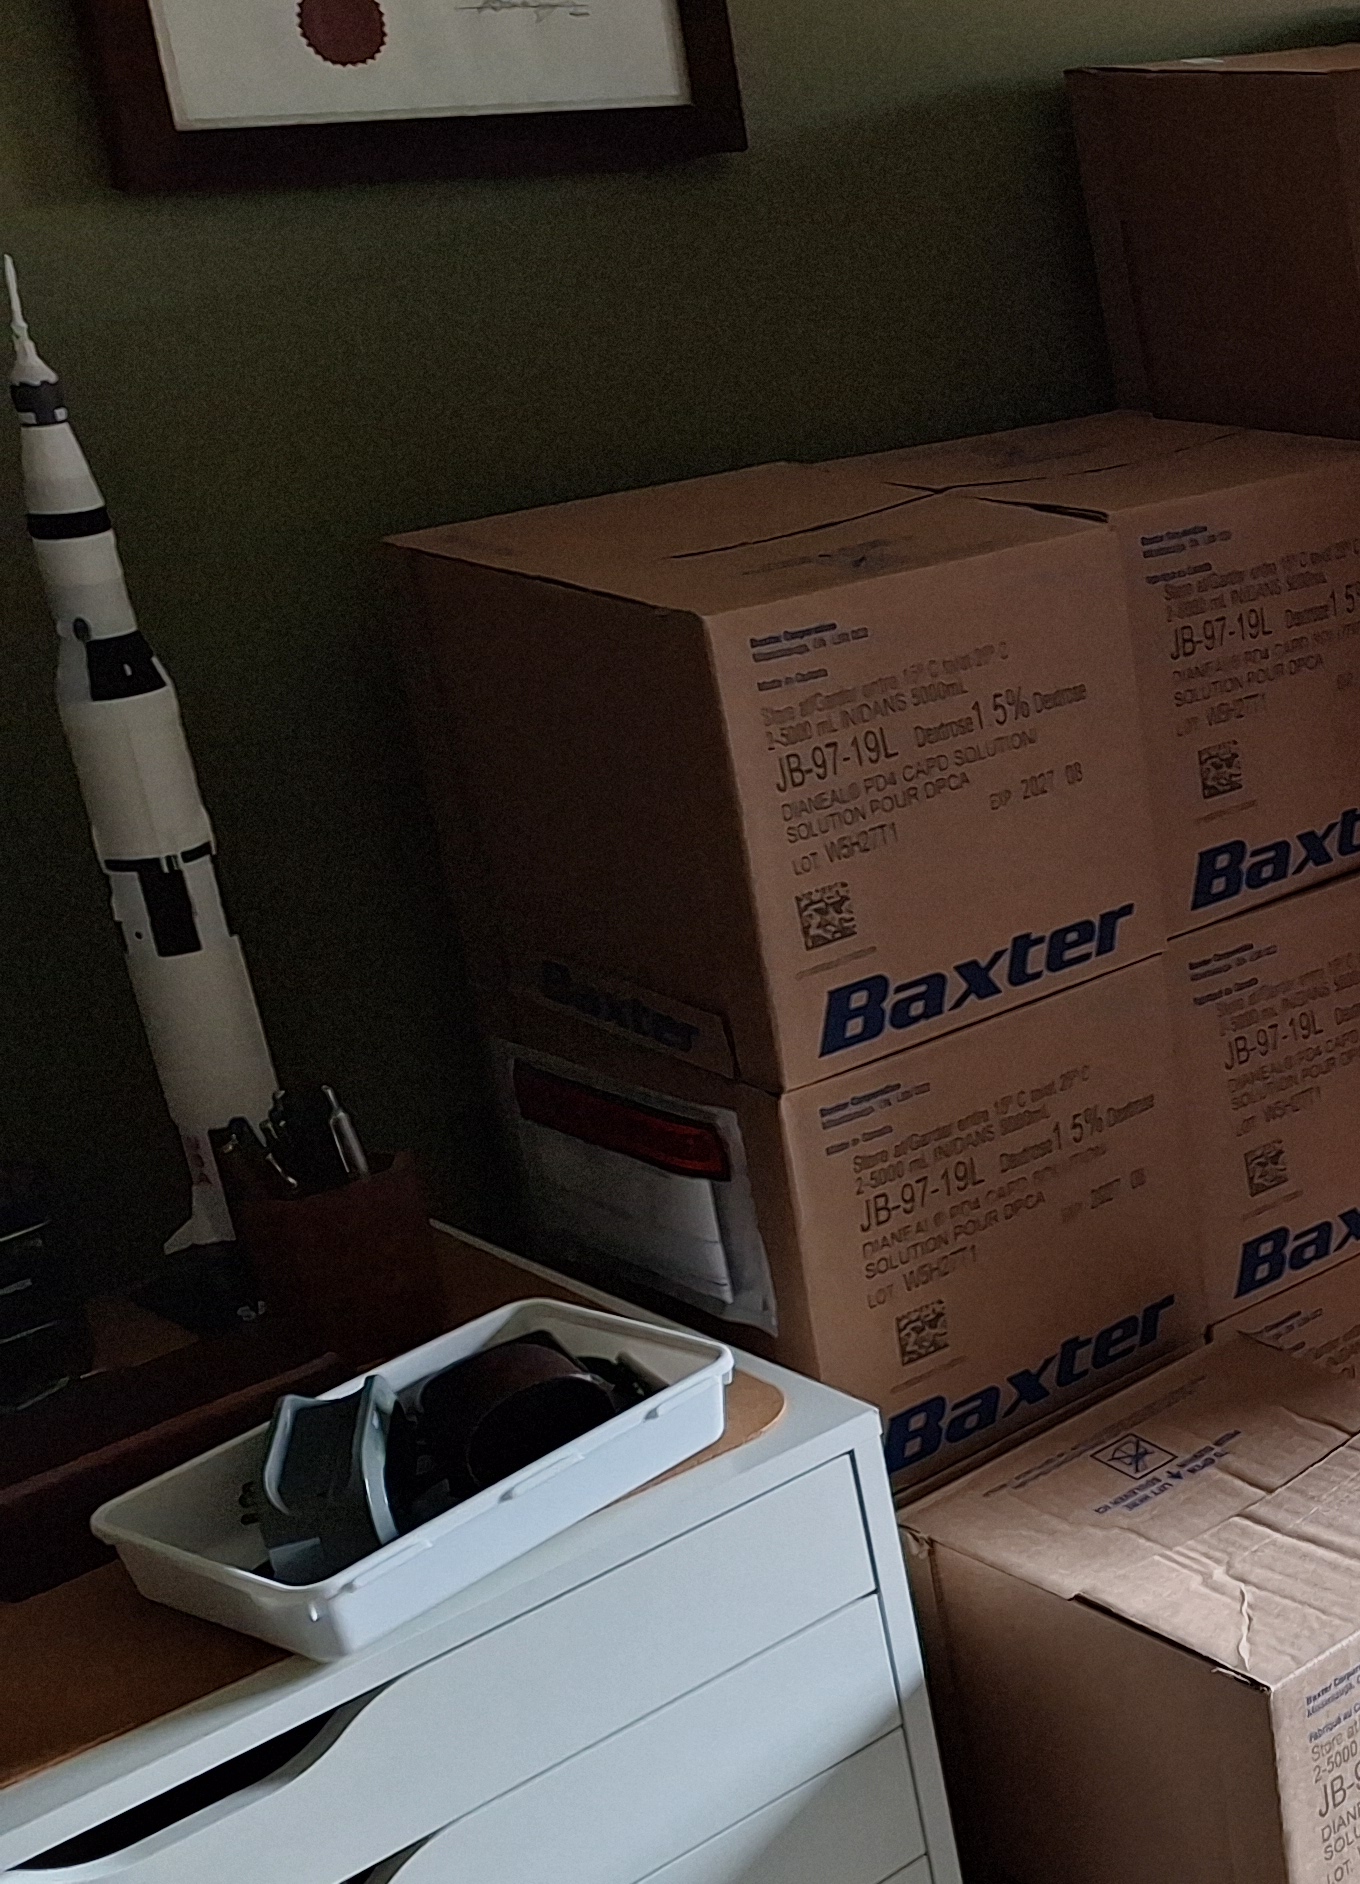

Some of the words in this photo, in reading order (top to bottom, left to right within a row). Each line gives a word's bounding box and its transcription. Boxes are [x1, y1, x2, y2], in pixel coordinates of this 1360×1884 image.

[1170, 607, 1274, 661] JB-97-19L
[775, 726, 899, 793] JB-97-19L
[785, 806, 868, 845] SOLUTION
[925, 771, 970, 801] DPCA
[818, 903, 1135, 1058] Baxter
[1224, 1009, 1325, 1071] JB-97-19L
[859, 1157, 986, 1233] JB-97-19L
[864, 1226, 950, 1279] SOLUTION
[884, 1294, 1176, 1473] Baxter
[1312, 1730, 1343, 1762] Store
[1313, 1740, 1358, 1783] 2-5000
